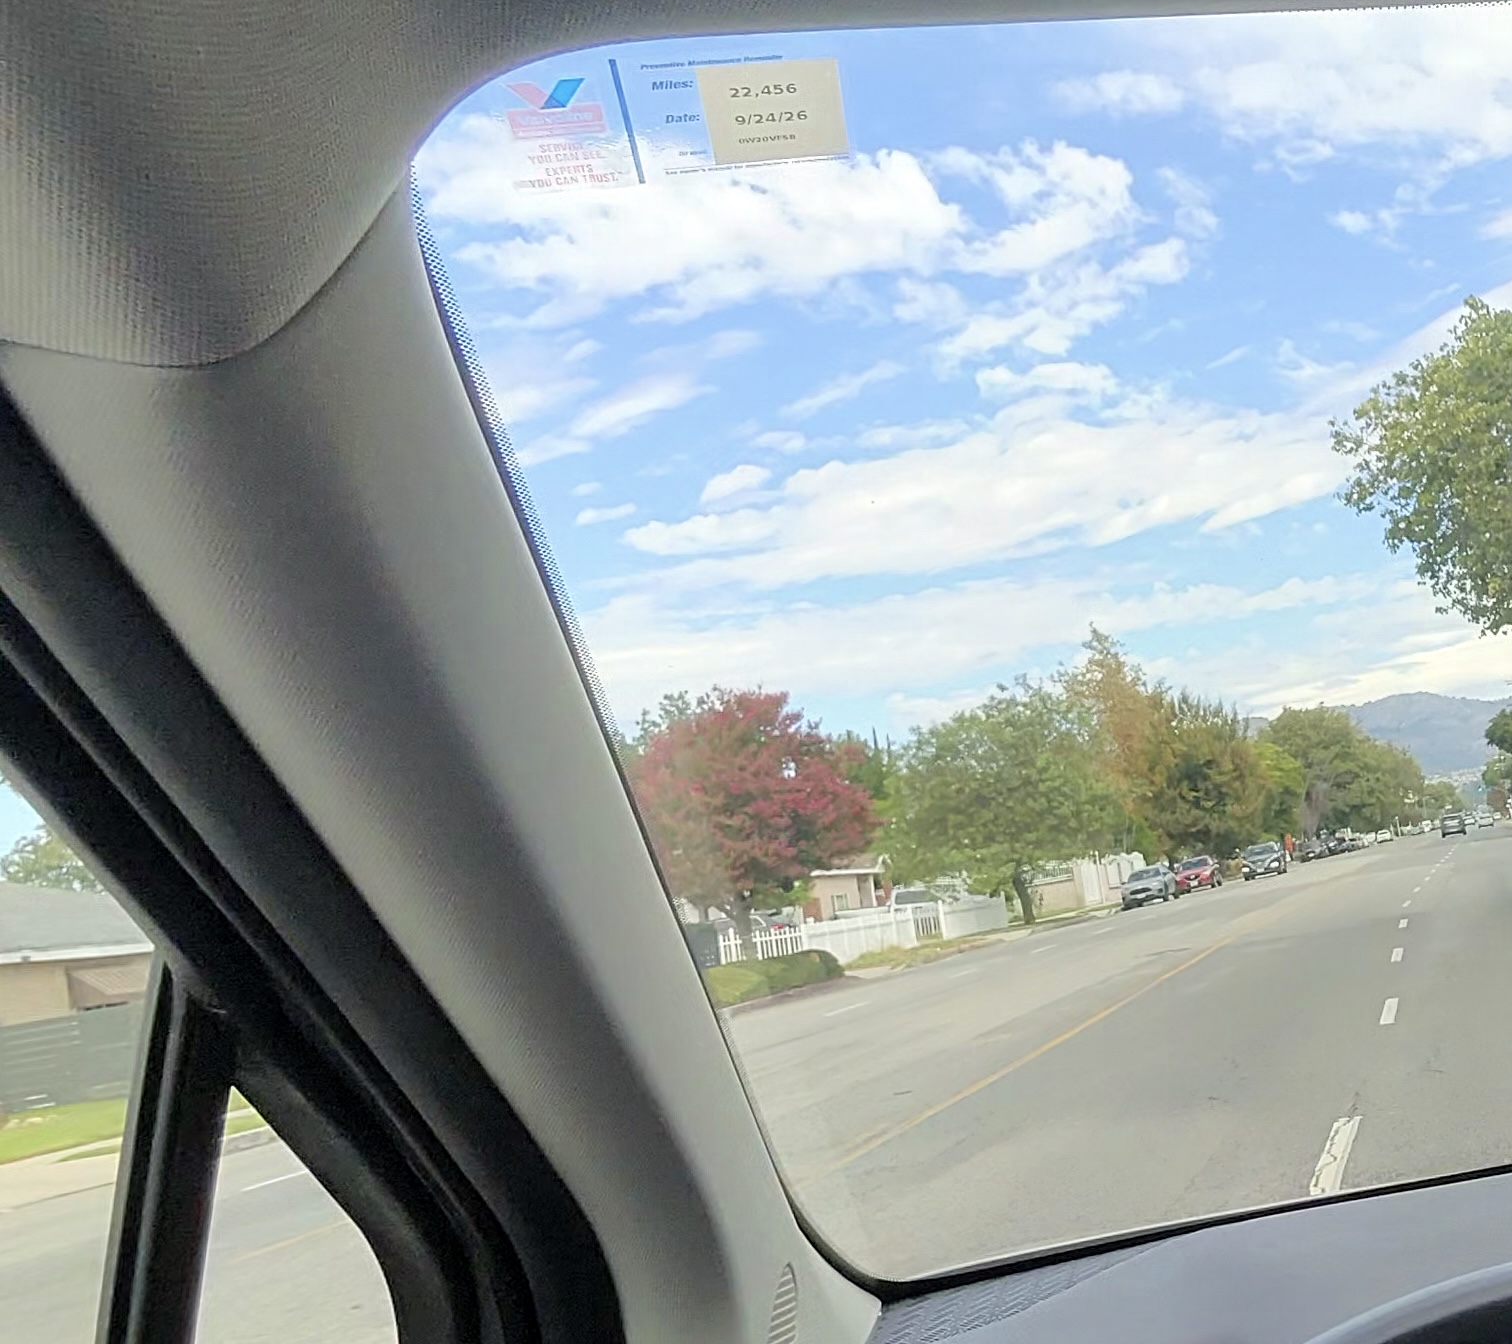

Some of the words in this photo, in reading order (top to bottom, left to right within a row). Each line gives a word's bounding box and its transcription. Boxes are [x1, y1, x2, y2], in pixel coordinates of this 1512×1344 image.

[651, 79, 694, 91] Miles:
[729, 83, 798, 99] 22,456
[665, 112, 700, 124] Date:
[735, 110, 809, 126] 9/24/26
[545, 164, 594, 177] EXPERTS
[556, 176, 579, 186] CAN
